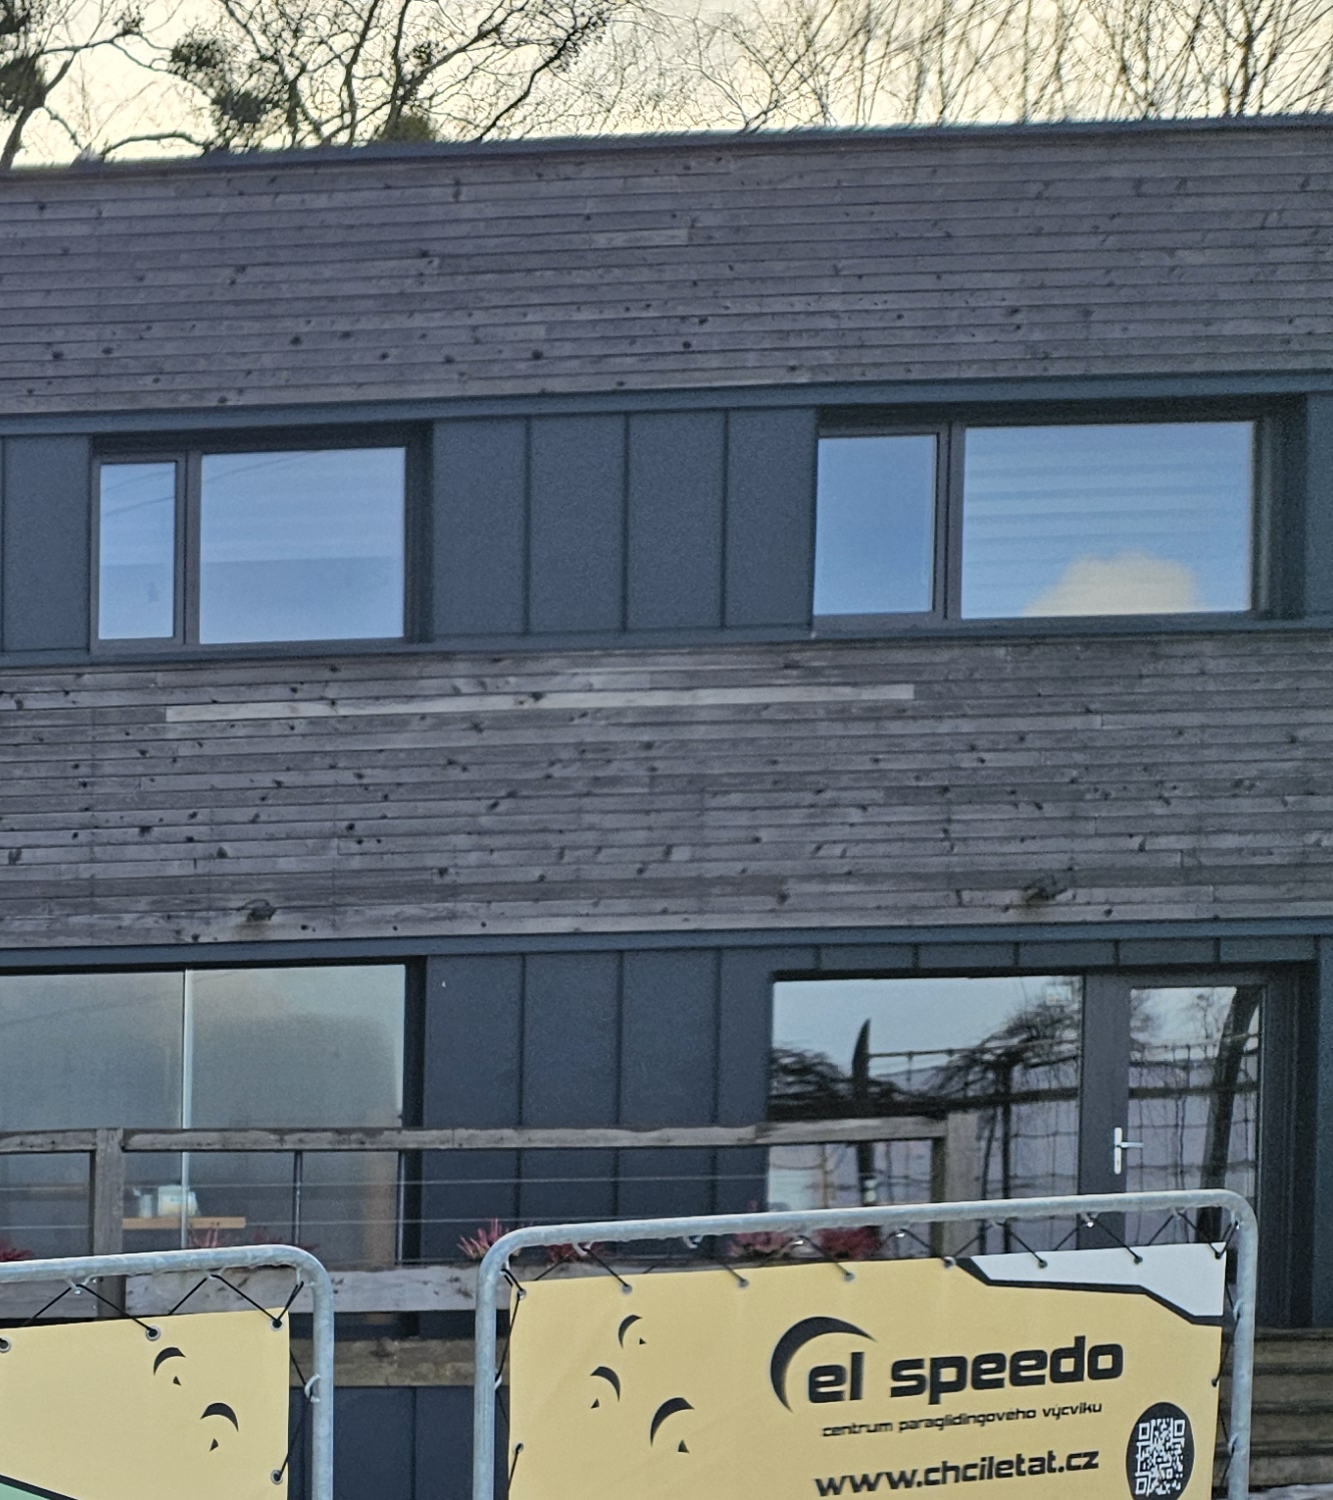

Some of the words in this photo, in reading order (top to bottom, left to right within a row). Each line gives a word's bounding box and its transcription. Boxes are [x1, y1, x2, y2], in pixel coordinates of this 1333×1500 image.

[807, 1351, 865, 1404] el
[890, 1335, 1124, 1405] speedo
[822, 1421, 894, 1438] centrum
[898, 1406, 1037, 1434] paraglidingového
[1042, 1401, 1103, 1420] výcviku
[814, 1450, 1100, 1497] www.chciletat.cz
